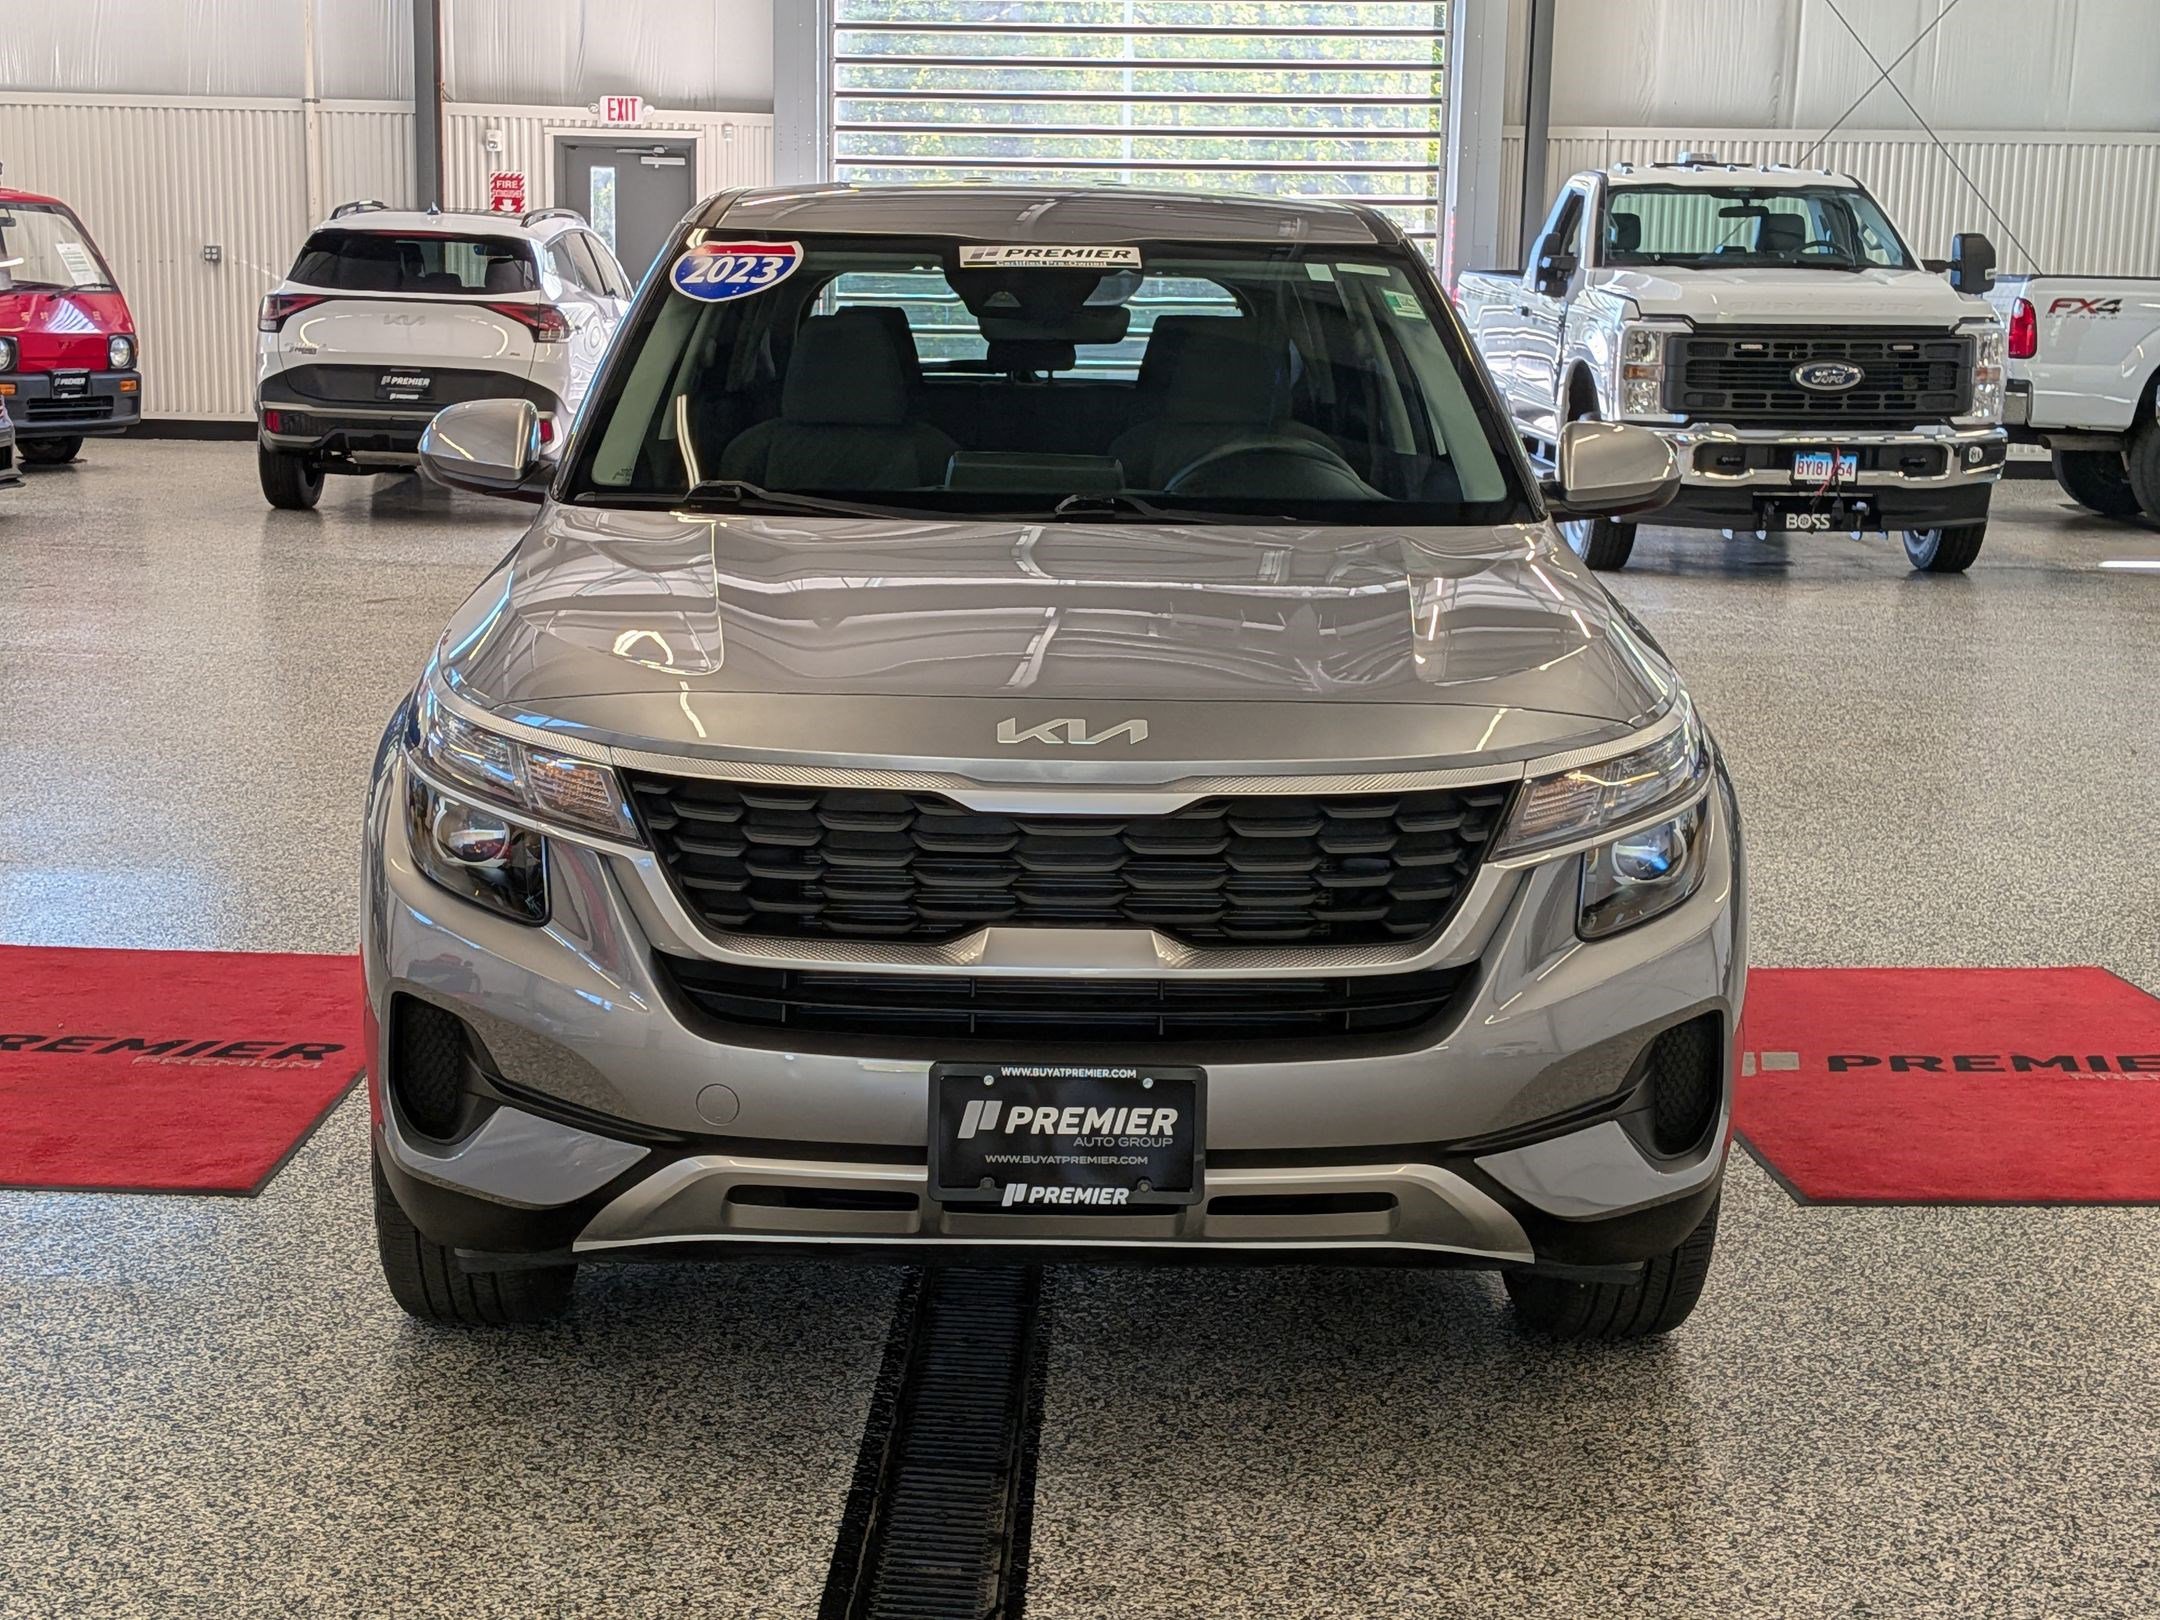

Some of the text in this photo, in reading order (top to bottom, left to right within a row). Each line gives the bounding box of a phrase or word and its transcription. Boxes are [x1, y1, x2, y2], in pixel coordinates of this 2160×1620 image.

[607, 97, 638, 122] EXIT
[496, 179, 519, 189] FIRE
[1004, 248, 1132, 259] PREMIER
[680, 256, 784, 284] 2023
[2047, 297, 2123, 315] FX4
[390, 376, 431, 388] PREMIER
[1810, 370, 1845, 385] Ford
[1785, 513, 1831, 530] BOSS
[997, 717, 1149, 745] KIA
[1001, 1066, 1137, 1079] WWW.BUYATPREMIER.COM
[1004, 1105, 1179, 1136] PREMIER
[1073, 1136, 1173, 1148] AUTO GROUP
[985, 1154, 1148, 1166] WWW.BUYATPREMIER.COM
[1028, 1186, 1130, 1206] PREMIER
